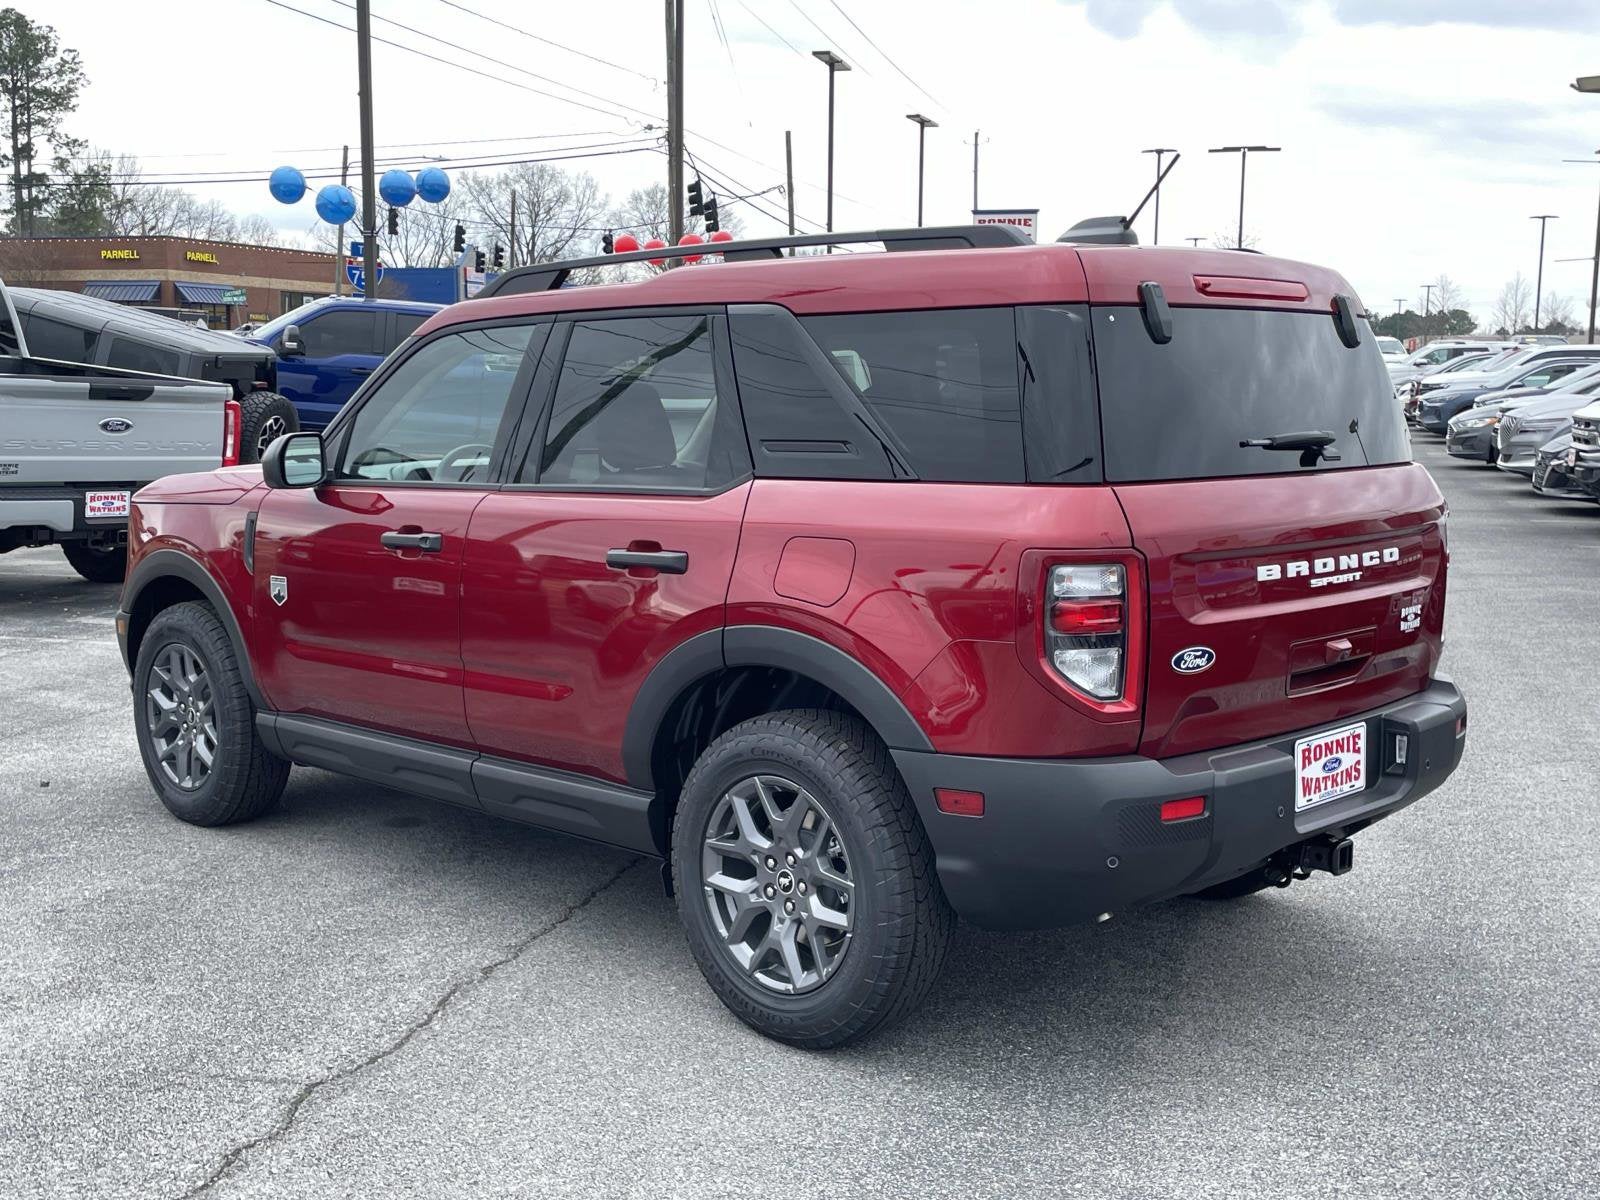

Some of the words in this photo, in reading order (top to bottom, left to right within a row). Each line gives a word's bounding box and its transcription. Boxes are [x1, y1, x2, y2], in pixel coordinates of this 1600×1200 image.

[977, 218, 1032, 227] RONNIE
[101, 250, 140, 259] PARNELL
[186, 251, 220, 265] PARNELL
[2, 440, 124, 450] SUPER
[133, 440, 213, 450] DUTY
[89, 494, 127, 502] RONNIE
[89, 504, 127, 513] WATKINS
[1256, 547, 1400, 582] BRONCO
[1310, 571, 1363, 588] SPORT
[1180, 650, 1209, 669] Ford
[1301, 732, 1361, 772] RONNIE
[1323, 758, 1341, 772] Ford
[1301, 760, 1361, 799] WATKINS
